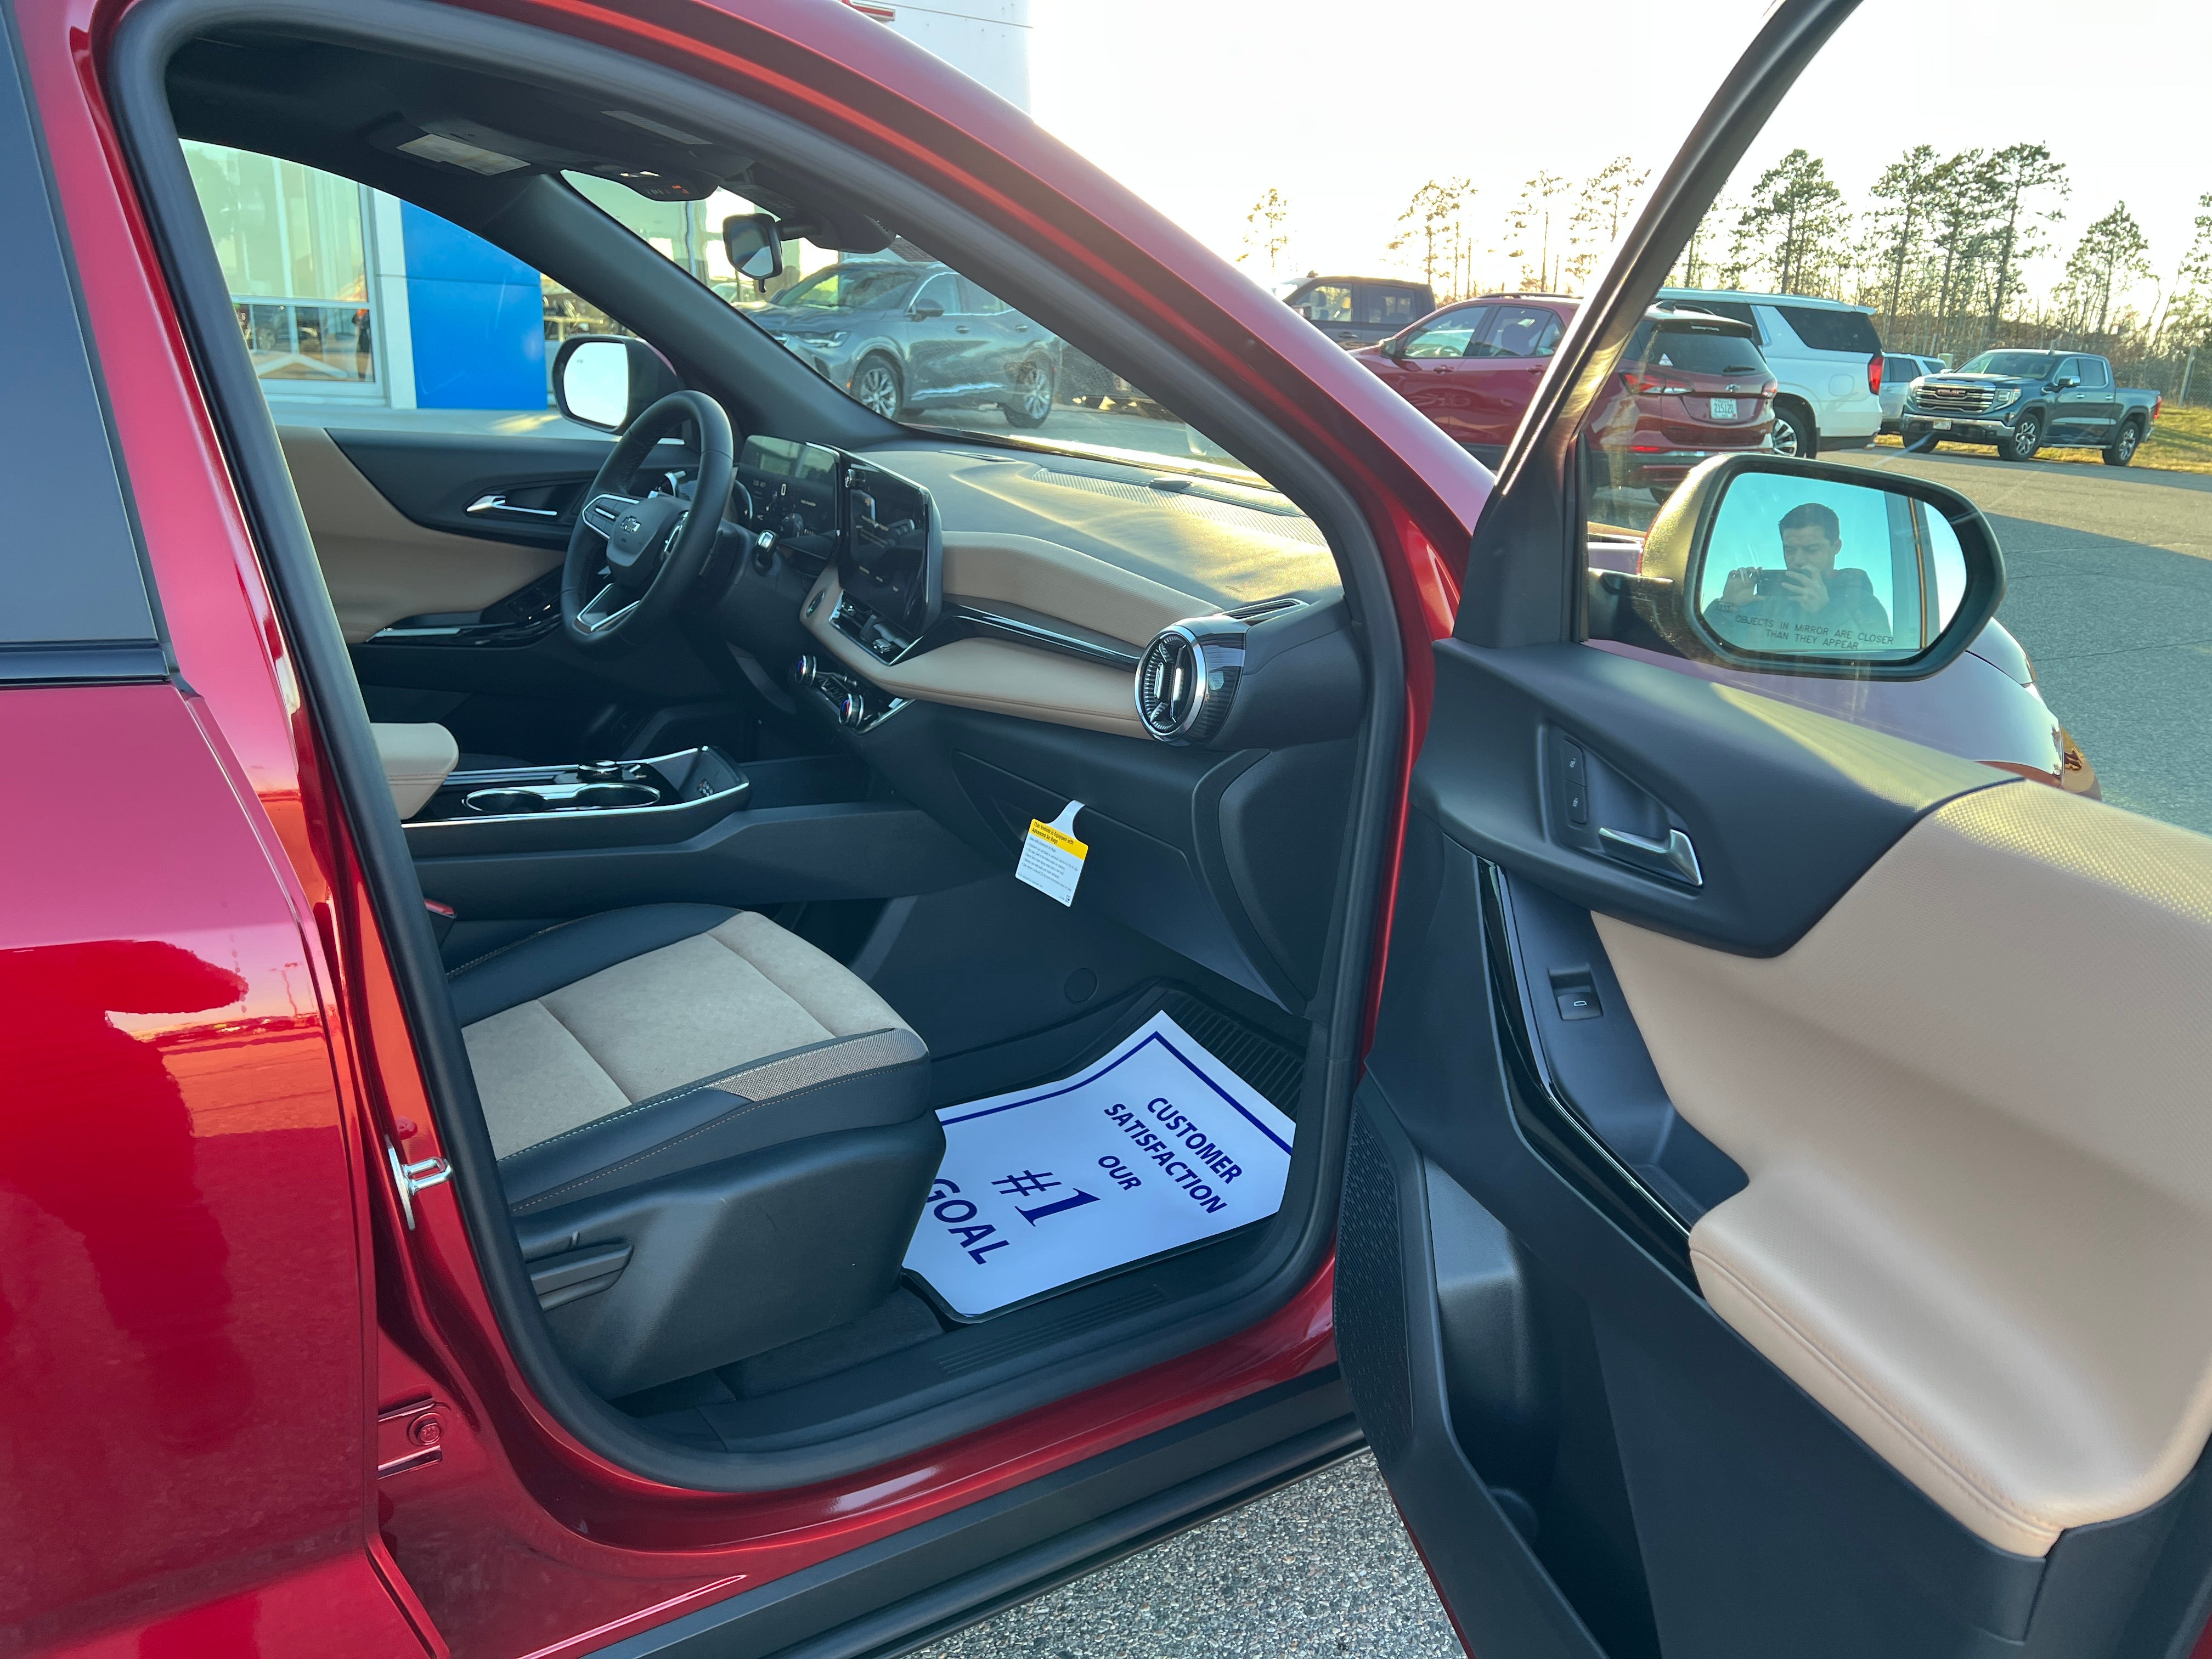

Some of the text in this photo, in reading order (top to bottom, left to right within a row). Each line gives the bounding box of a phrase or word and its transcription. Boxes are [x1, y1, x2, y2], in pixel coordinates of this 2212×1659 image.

[1735, 614, 1774, 628] OBJECTS
[1795, 623, 1829, 636] MIRROR
[1835, 629, 1852, 639] ARE
[1858, 632, 1894, 645] CLOSER
[1766, 629, 1859, 650] THAN THEY APPEAR
[1104, 1104, 1227, 1214] SATISFACTION
[1148, 1098, 1242, 1184] CUSTOMER
[991, 1170, 1101, 1227] #1
[1098, 1155, 1141, 1191] OUR
[928, 1179, 1009, 1265] GOAL
